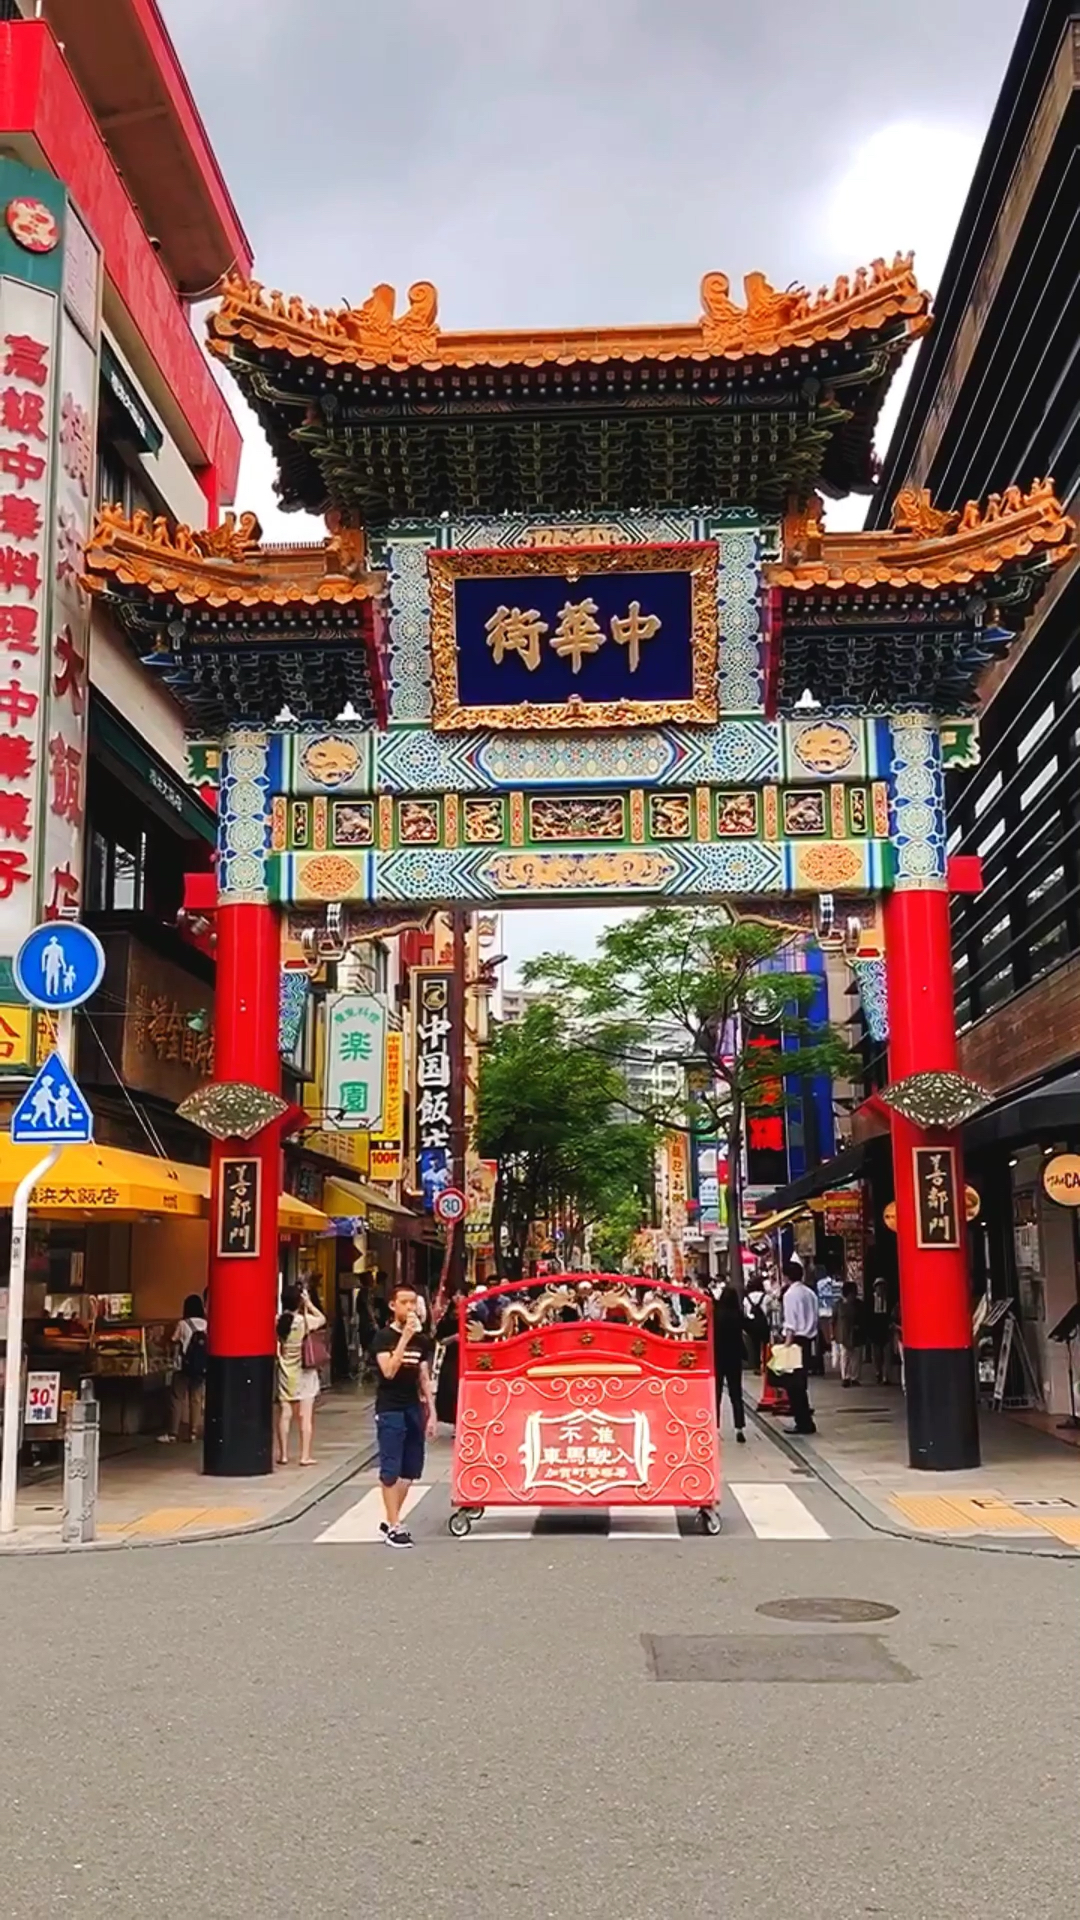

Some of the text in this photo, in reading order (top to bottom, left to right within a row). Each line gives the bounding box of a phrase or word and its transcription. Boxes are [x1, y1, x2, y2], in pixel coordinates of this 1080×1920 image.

[339, 1031, 372, 1112] 楽園
[442, 1198, 460, 1214] 30
[559, 1426, 616, 1444] 不准
